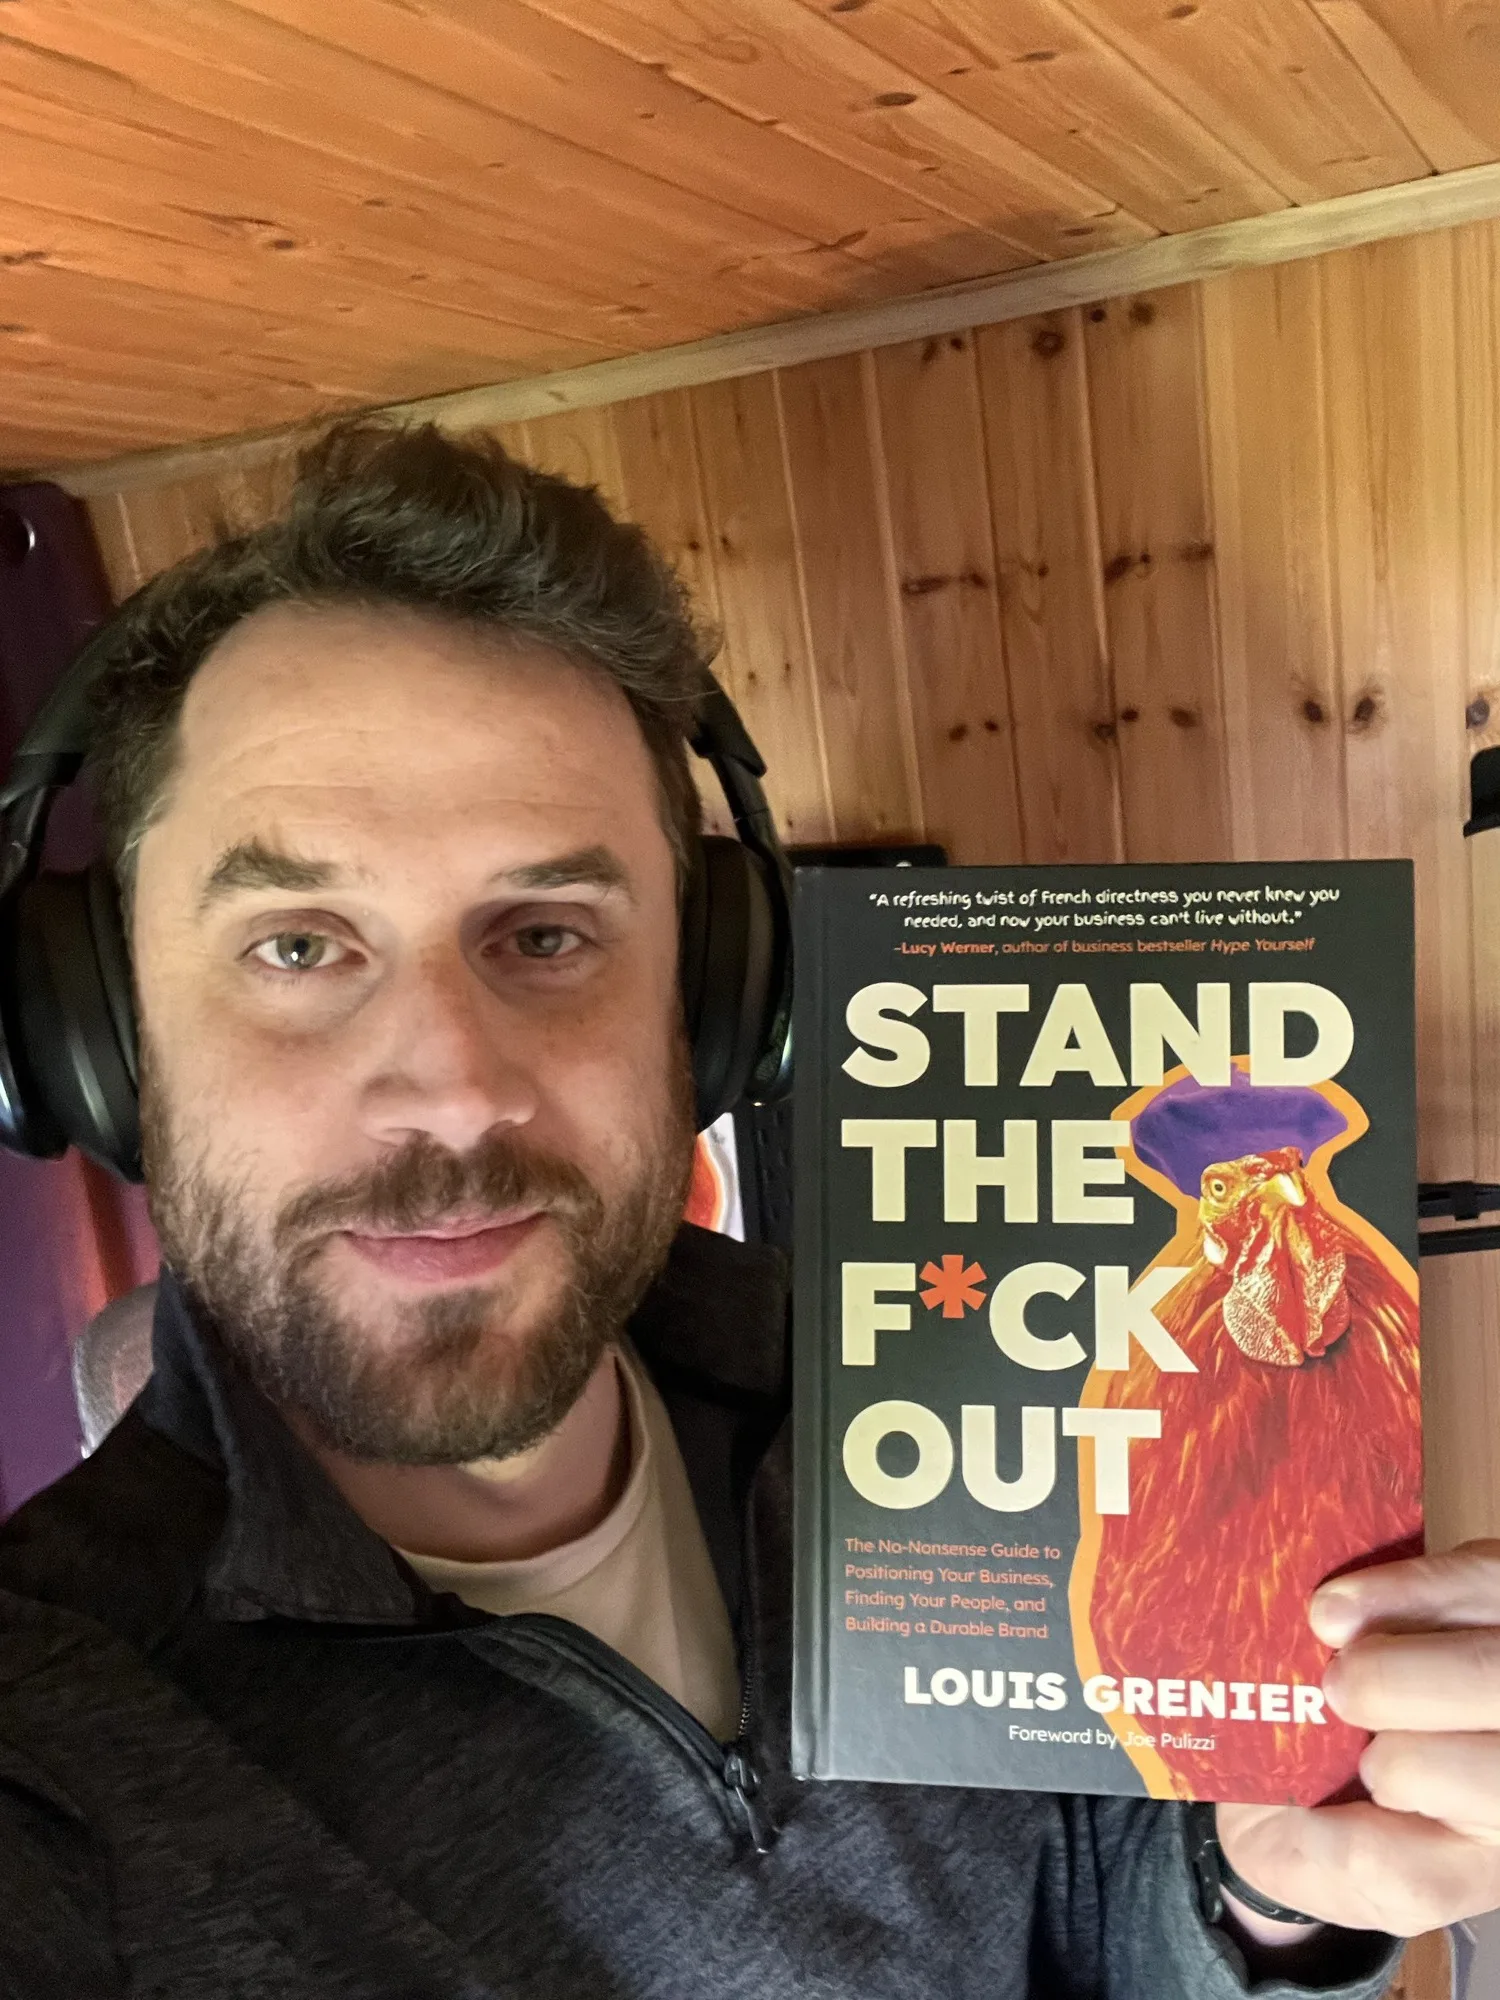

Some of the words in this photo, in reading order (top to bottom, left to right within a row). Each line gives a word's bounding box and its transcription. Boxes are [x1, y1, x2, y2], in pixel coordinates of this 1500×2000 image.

[893, 890, 972, 910] refreshing
[975, 890, 1016, 906] twist
[1019, 888, 1038, 906] of
[1041, 889, 1092, 906] French
[1095, 888, 1179, 905] directness
[1183, 891, 1212, 908] you
[1216, 890, 1261, 903] never
[1265, 885, 1305, 903] knew
[1309, 888, 1340, 907] you
[904, 914, 963, 928] needed,
[967, 914, 996, 928] and
[1000, 914, 1030, 928] now
[1034, 914, 1070, 931] your
[1074, 911, 1145, 927] business
[1150, 911, 1191, 926] can't
[1194, 910, 1224, 925] live
[940, 941, 999, 956] Werner,
[1002, 939, 1050, 954] author
[1053, 939, 1069, 954] of
[1072, 938, 1133, 953] business
[1137, 938, 1207, 952] bestseller
[1210, 938, 1250, 955] Hype
[1255, 936, 1316, 951] Yourself
[841, 981, 1355, 1088] STAND
[841, 1118, 1135, 1224] THE
[841, 1399, 1162, 1516] OUT
[845, 1537, 875, 1553] The
[878, 1539, 987, 1557] No-Nonsense
[990, 1542, 1040, 1559] Guide
[1044, 1546, 1061, 1560] to
[844, 1564, 934, 1585] Positioning
[938, 1567, 976, 1583] Your
[979, 1568, 1056, 1589] Business,
[844, 1589, 906, 1610] Finding
[909, 1592, 946, 1608] Your
[950, 1594, 1011, 1613] People,
[1013, 1597, 1046, 1612] and
[844, 1616, 911, 1638] Building
[914, 1622, 926, 1634] a
[929, 1619, 995, 1637] Durable
[998, 1622, 1049, 1639] Brand
[903, 1665, 1067, 1712] LOUIS
[1082, 1674, 1328, 1725] GRENIER
[1008, 1724, 1092, 1746] Foreword
[1095, 1728, 1117, 1750] by
[1122, 1731, 1157, 1750] Joe
[1160, 1732, 1216, 1752] Pulizzi
